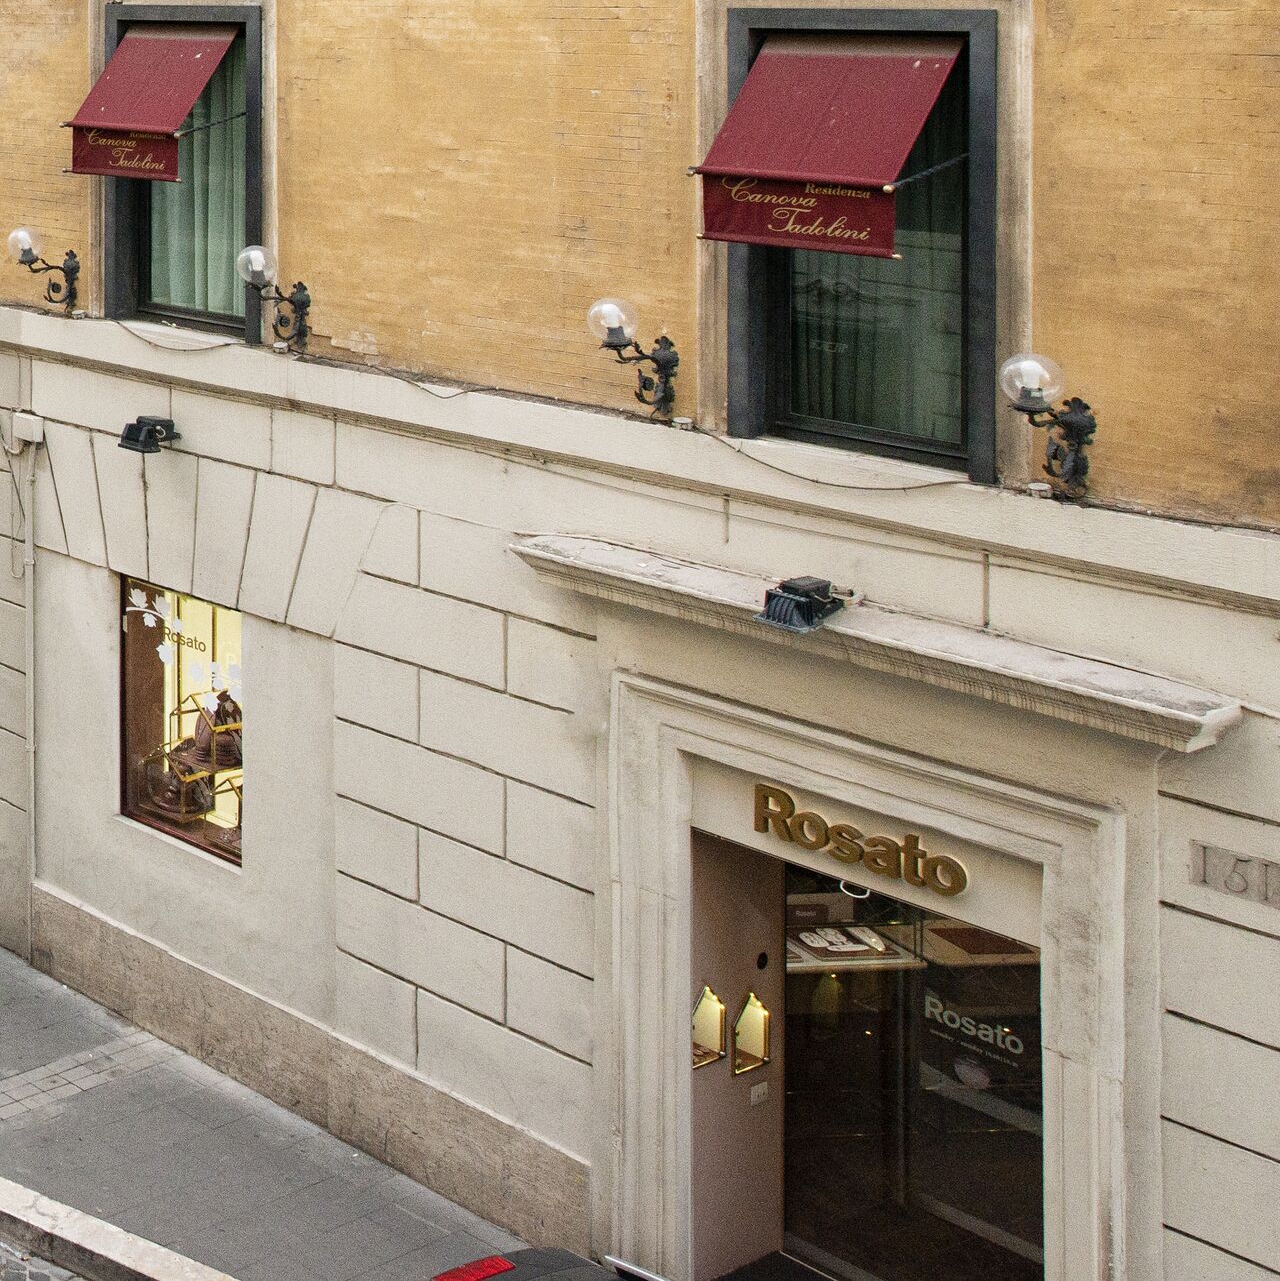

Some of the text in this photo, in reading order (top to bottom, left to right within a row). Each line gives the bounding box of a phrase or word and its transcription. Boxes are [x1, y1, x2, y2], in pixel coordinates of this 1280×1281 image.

[83, 127, 138, 148] Canova
[108, 147, 166, 171] Tadolini
[721, 176, 818, 208] Canova
[804, 182, 871, 199] Residenza
[767, 207, 871, 241] Tadolini
[163, 627, 207, 653] Rosato
[754, 783, 968, 897] Rosato
[1200, 845, 1269, 901] 151
[924, 993, 1024, 1055] Rosato
